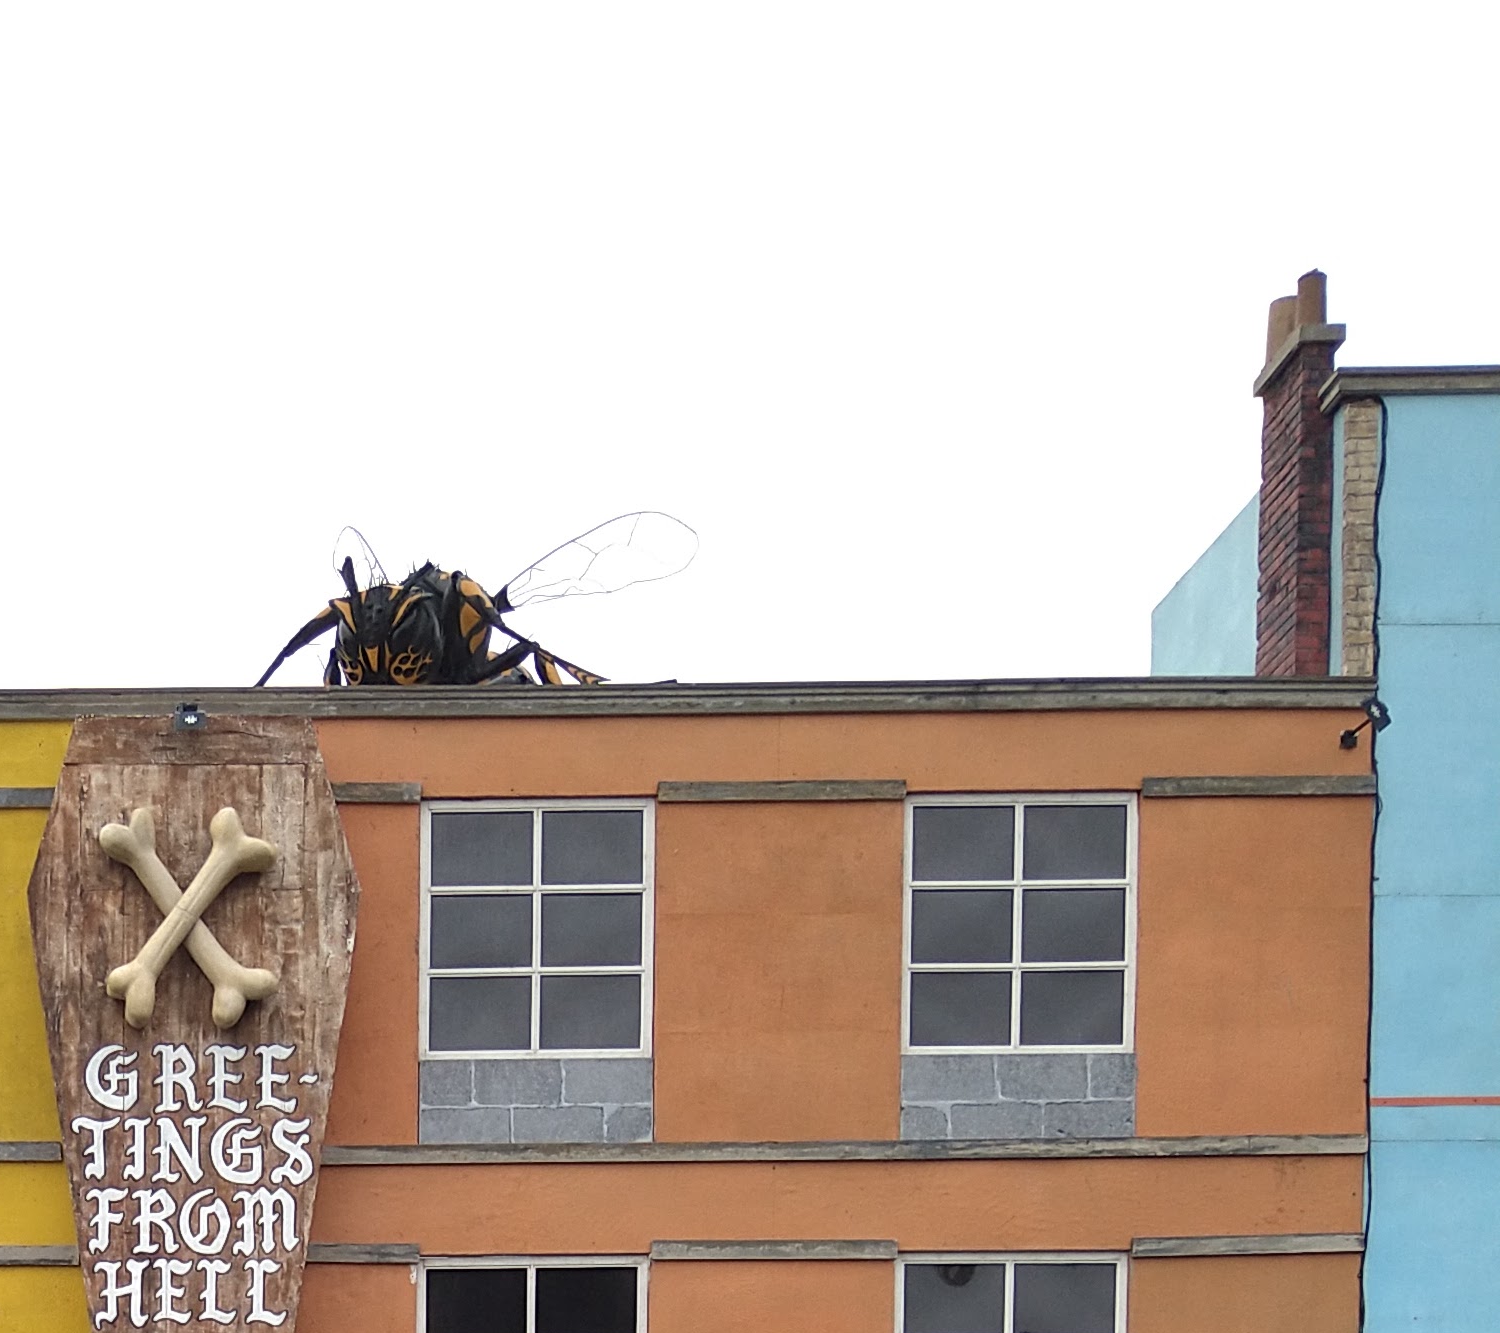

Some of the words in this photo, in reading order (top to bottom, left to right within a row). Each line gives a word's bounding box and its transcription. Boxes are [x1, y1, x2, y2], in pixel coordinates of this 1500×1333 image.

[85, 1044, 319, 1113] GREE-
[71, 1116, 314, 1185] TINGS
[85, 1187, 300, 1256] FROM
[93, 1258, 288, 1330] HELL
